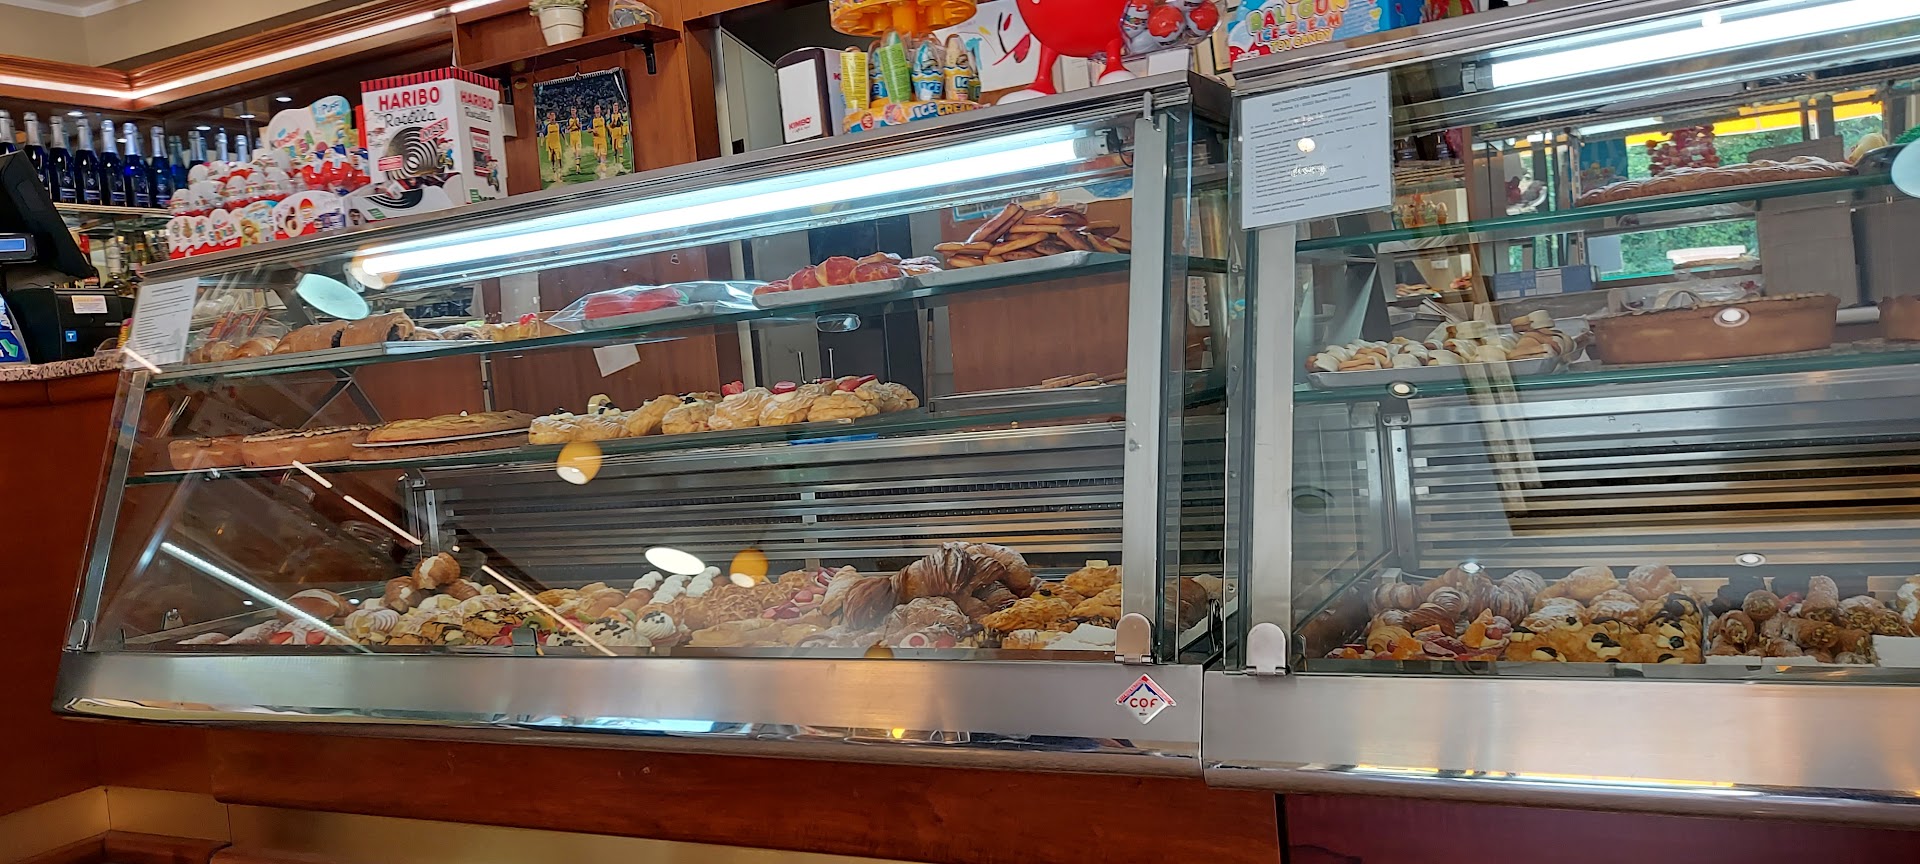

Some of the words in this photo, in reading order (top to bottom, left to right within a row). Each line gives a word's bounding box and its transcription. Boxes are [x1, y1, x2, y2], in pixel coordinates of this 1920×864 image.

[1270, 40, 1291, 52] TOY
[1293, 29, 1333, 47] CANDY
[920, 80, 942, 96] ICE
[956, 76, 969, 88] IC
[378, 86, 440, 112] HARIBO
[460, 90, 495, 111] HARIBO
[912, 101, 937, 119] ICE
[788, 116, 812, 130] KIMBO
[1129, 697, 1158, 708] COF
